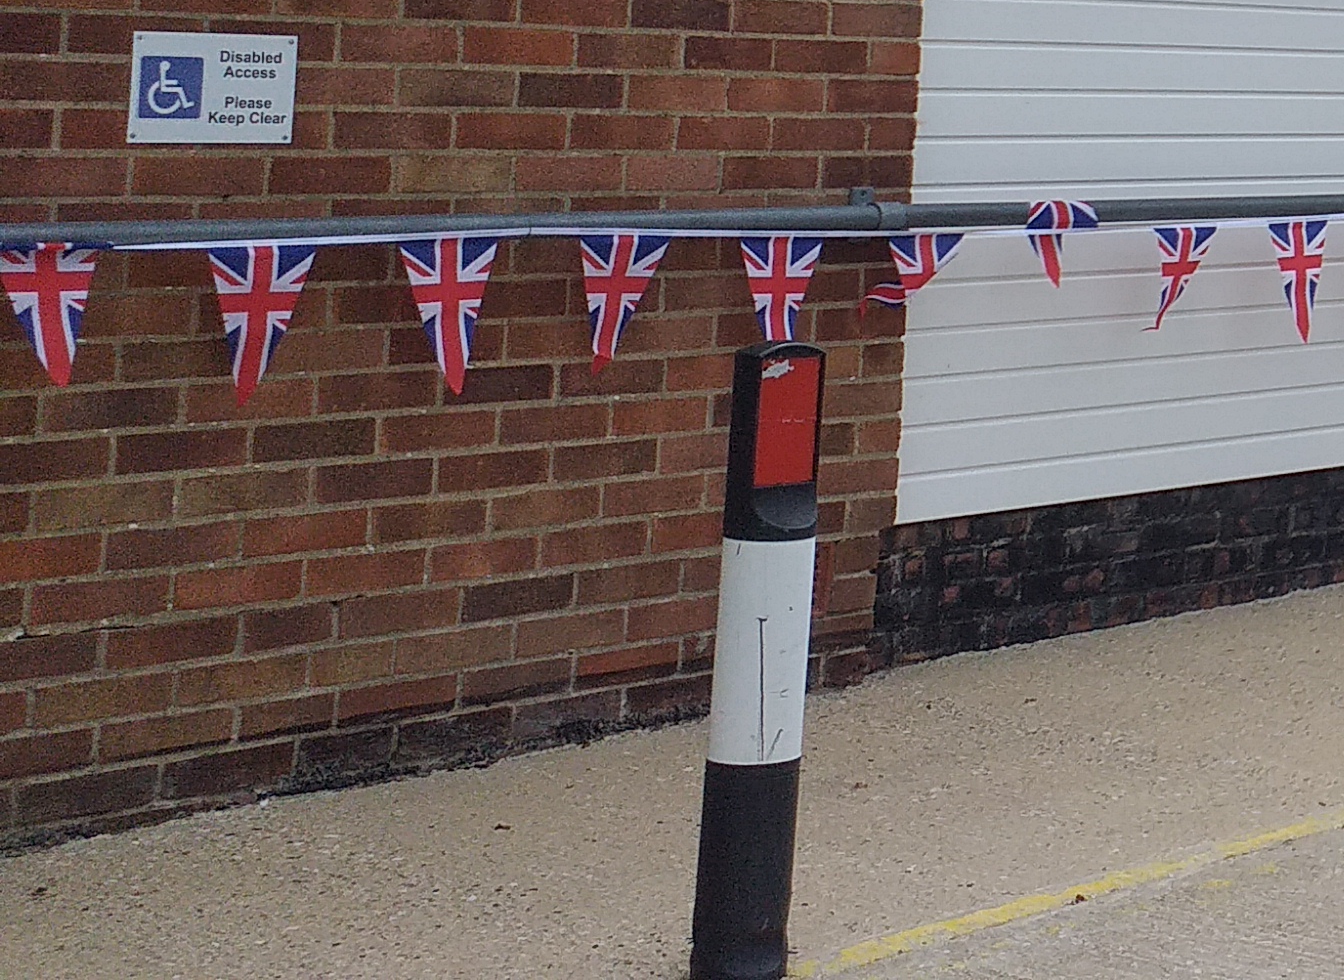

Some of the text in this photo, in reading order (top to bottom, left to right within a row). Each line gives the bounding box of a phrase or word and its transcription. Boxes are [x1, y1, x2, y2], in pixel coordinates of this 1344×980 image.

[220, 50, 283, 64] Disabled
[223, 66, 277, 79] Access
[225, 96, 273, 109] Please
[208, 111, 287, 127] Keep Clear
